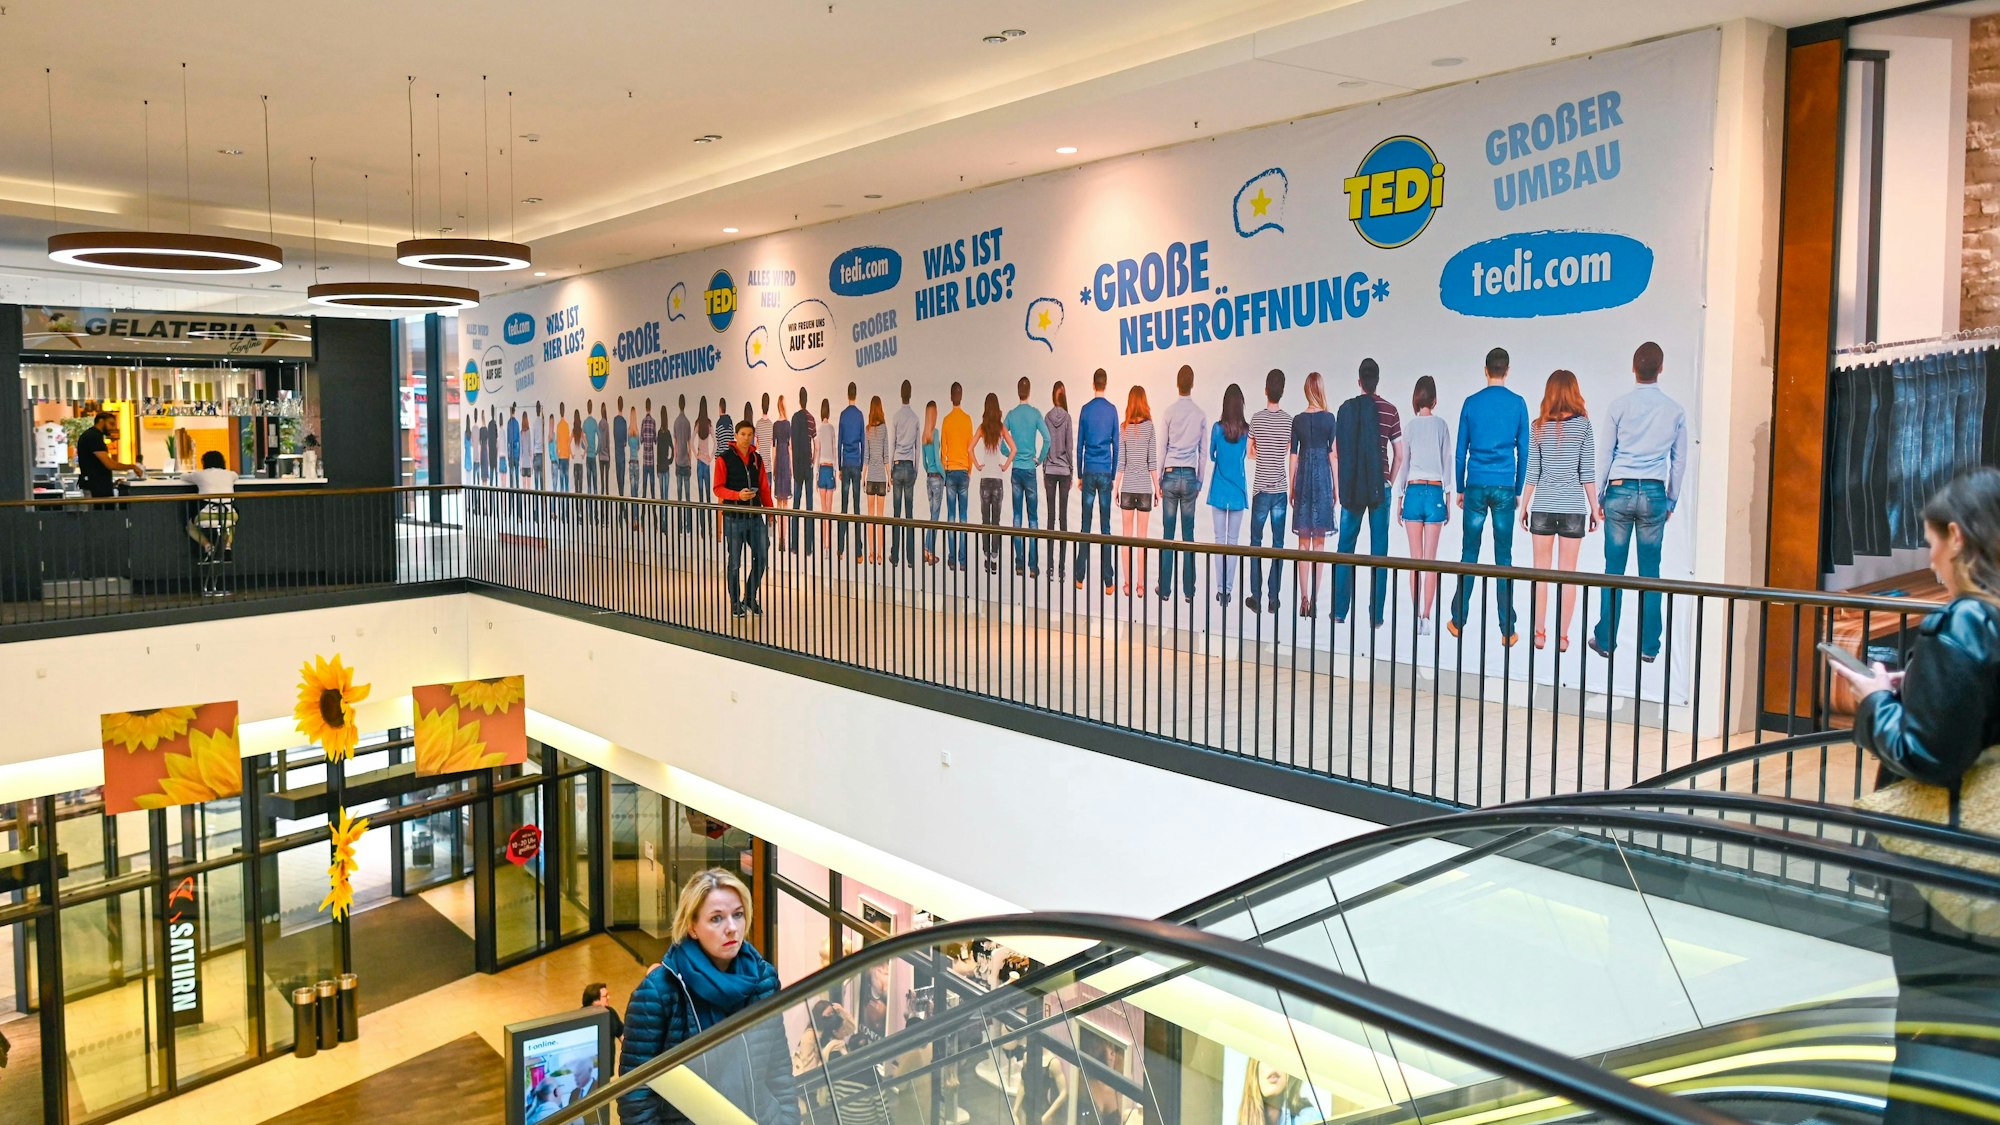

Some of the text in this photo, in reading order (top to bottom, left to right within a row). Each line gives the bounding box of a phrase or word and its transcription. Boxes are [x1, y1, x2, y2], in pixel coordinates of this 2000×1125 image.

[1486, 90, 1623, 167] GROßER
[1494, 139, 1622, 212] UMBAU
[1343, 162, 1446, 222] TEDi
[923, 227, 1003, 280] WAS IST
[747, 270, 796, 287] ALLES WIRD
[840, 255, 889, 285] tedi.com
[1472, 247, 1612, 297] tedi.com
[704, 286, 737, 316] TEDi
[760, 291, 781, 309] NEU!
[915, 262, 1016, 321] HIER LOS?
[85, 317, 258, 341] GELATERIA
[508, 318, 530, 337] tedi.com
[546, 305, 580, 335] WAS IST
[788, 318, 825, 332] WIR FREUEN UNS
[543, 328, 585, 363] HIER LOS?
[789, 331, 824, 352] AUF SIE!
[855, 336, 898, 368] UMBAU
[515, 371, 535, 392] UMBAU
[587, 356, 610, 377] TEDi
[463, 372, 480, 392] TEDi
[170, 922, 196, 1012] SATURN
